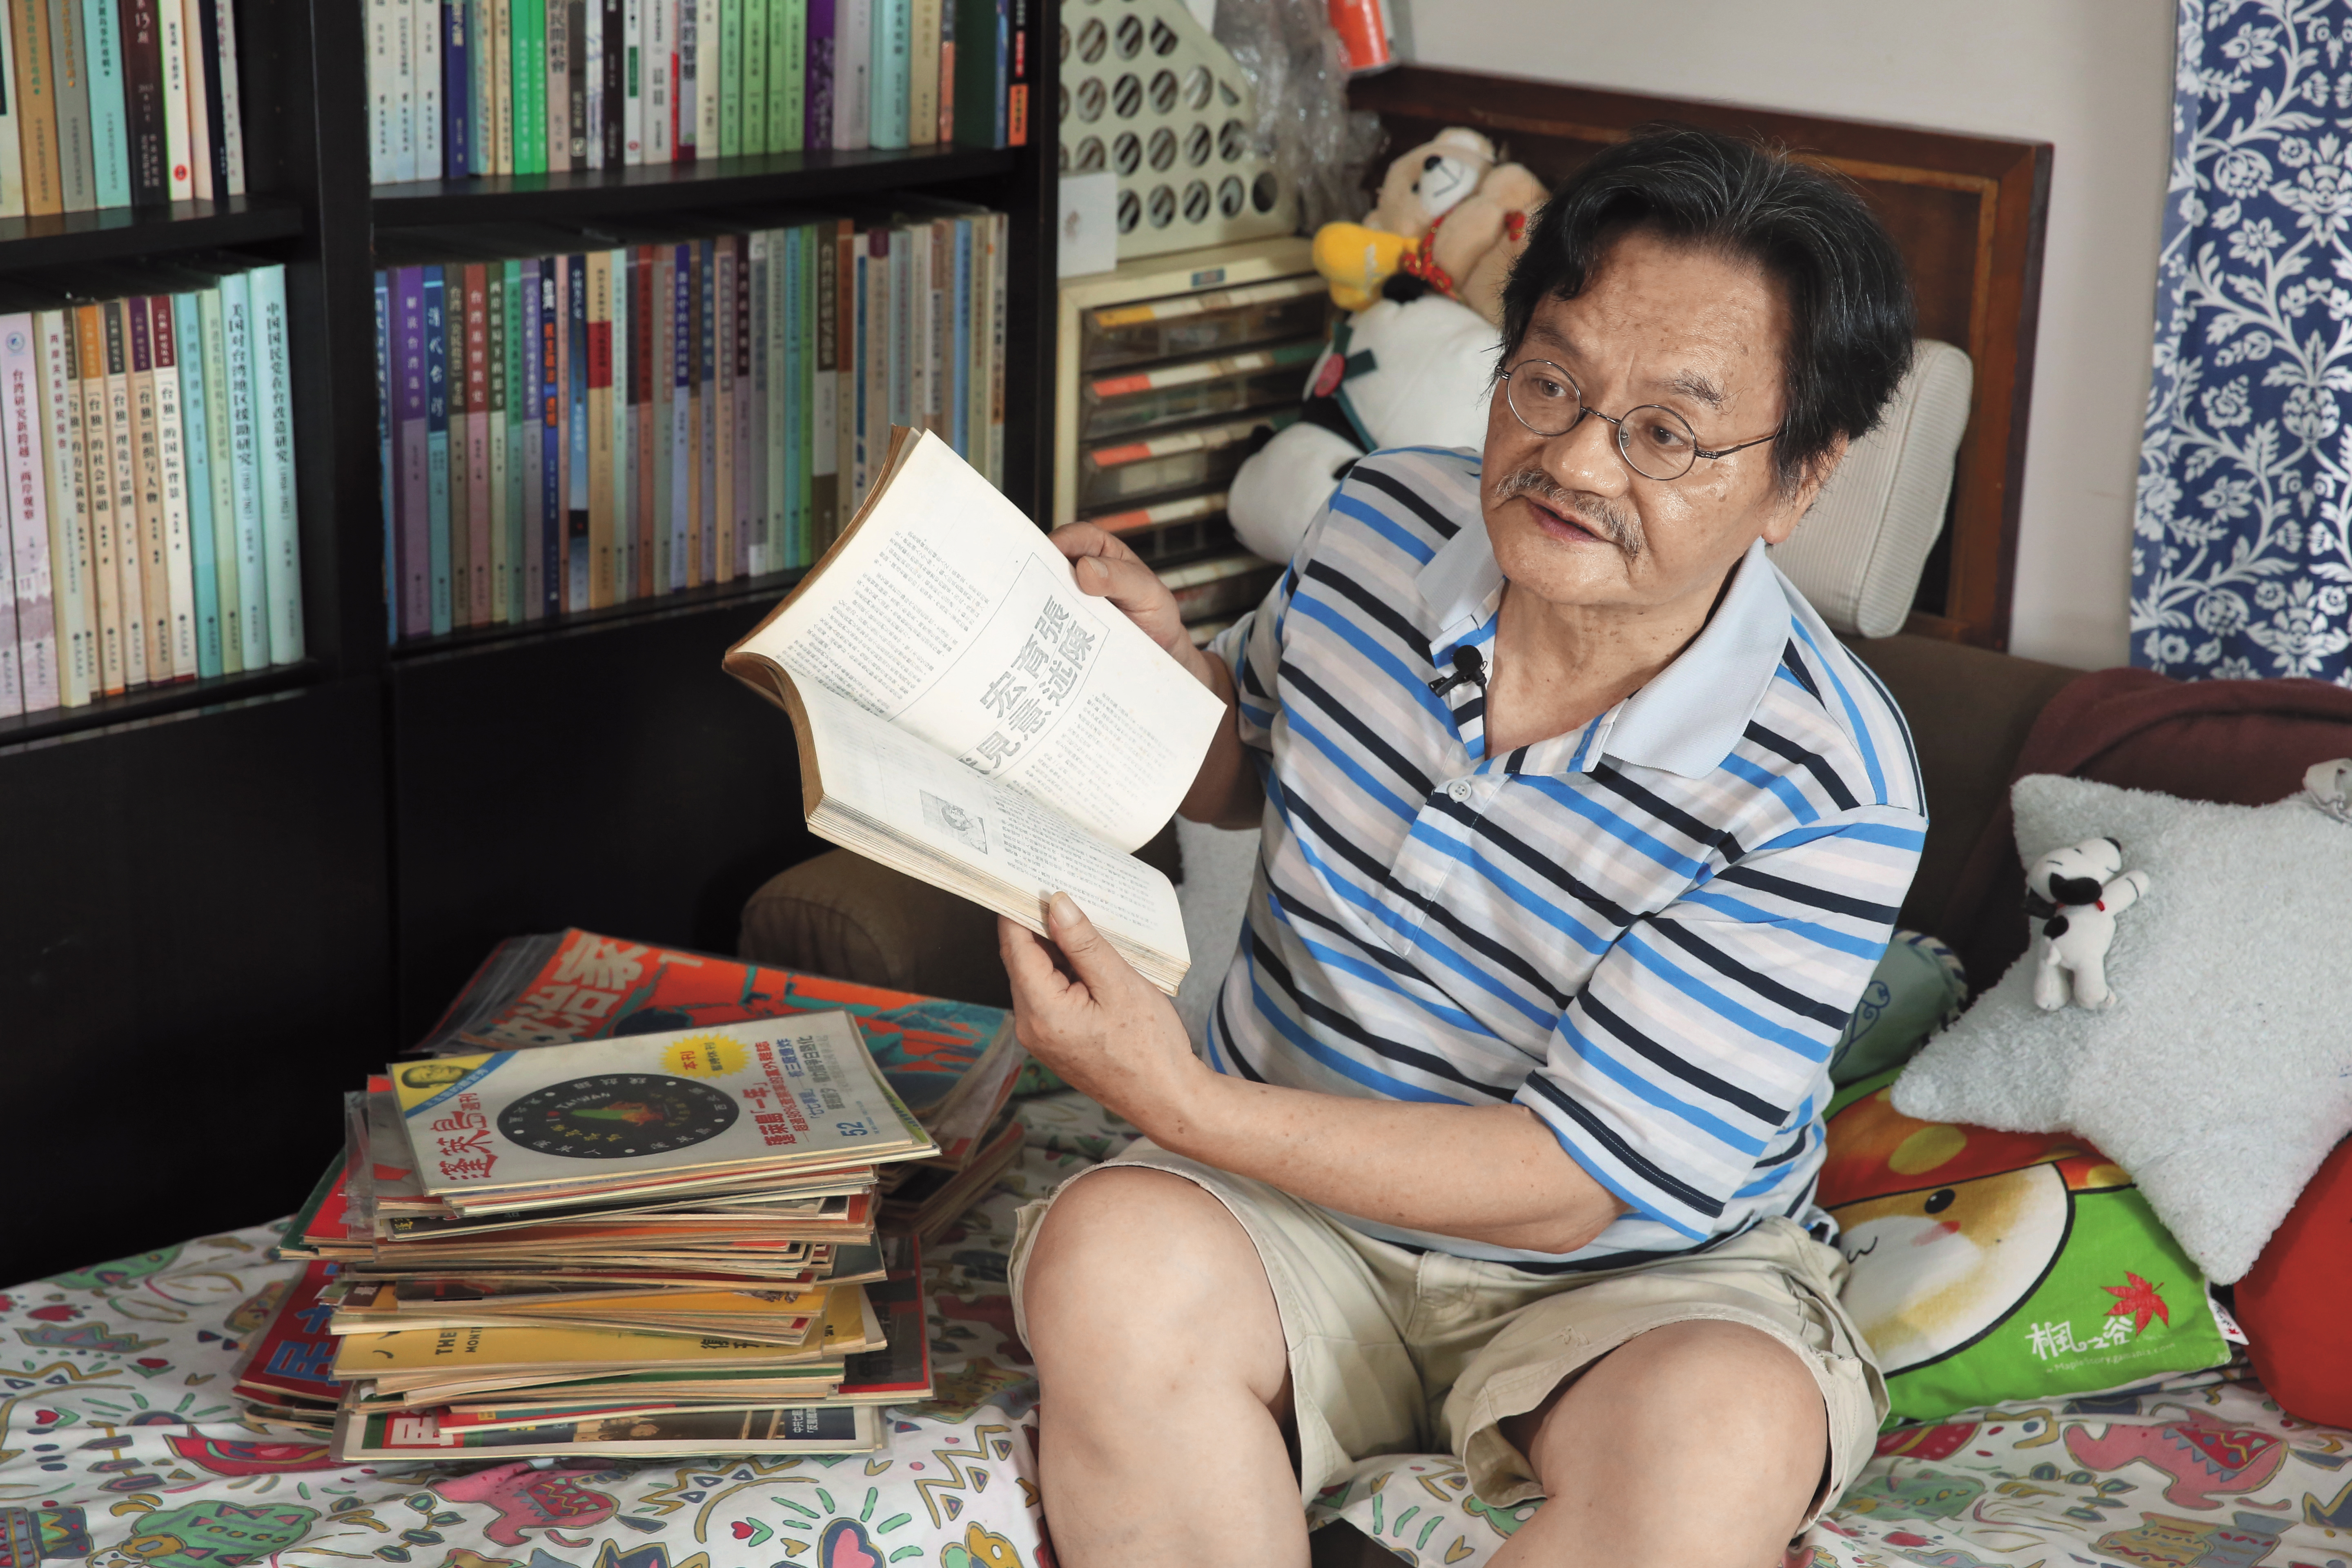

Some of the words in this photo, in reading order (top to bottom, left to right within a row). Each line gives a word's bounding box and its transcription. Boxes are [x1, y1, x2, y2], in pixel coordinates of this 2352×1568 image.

[680, 1051, 697, 1071] 本刊
[835, 1121, 869, 1137] 52
[430, 1110, 499, 1180] 蓬萊島
[434, 1332, 458, 1355] THE
[2025, 1316, 2134, 1360] 楓之谷
